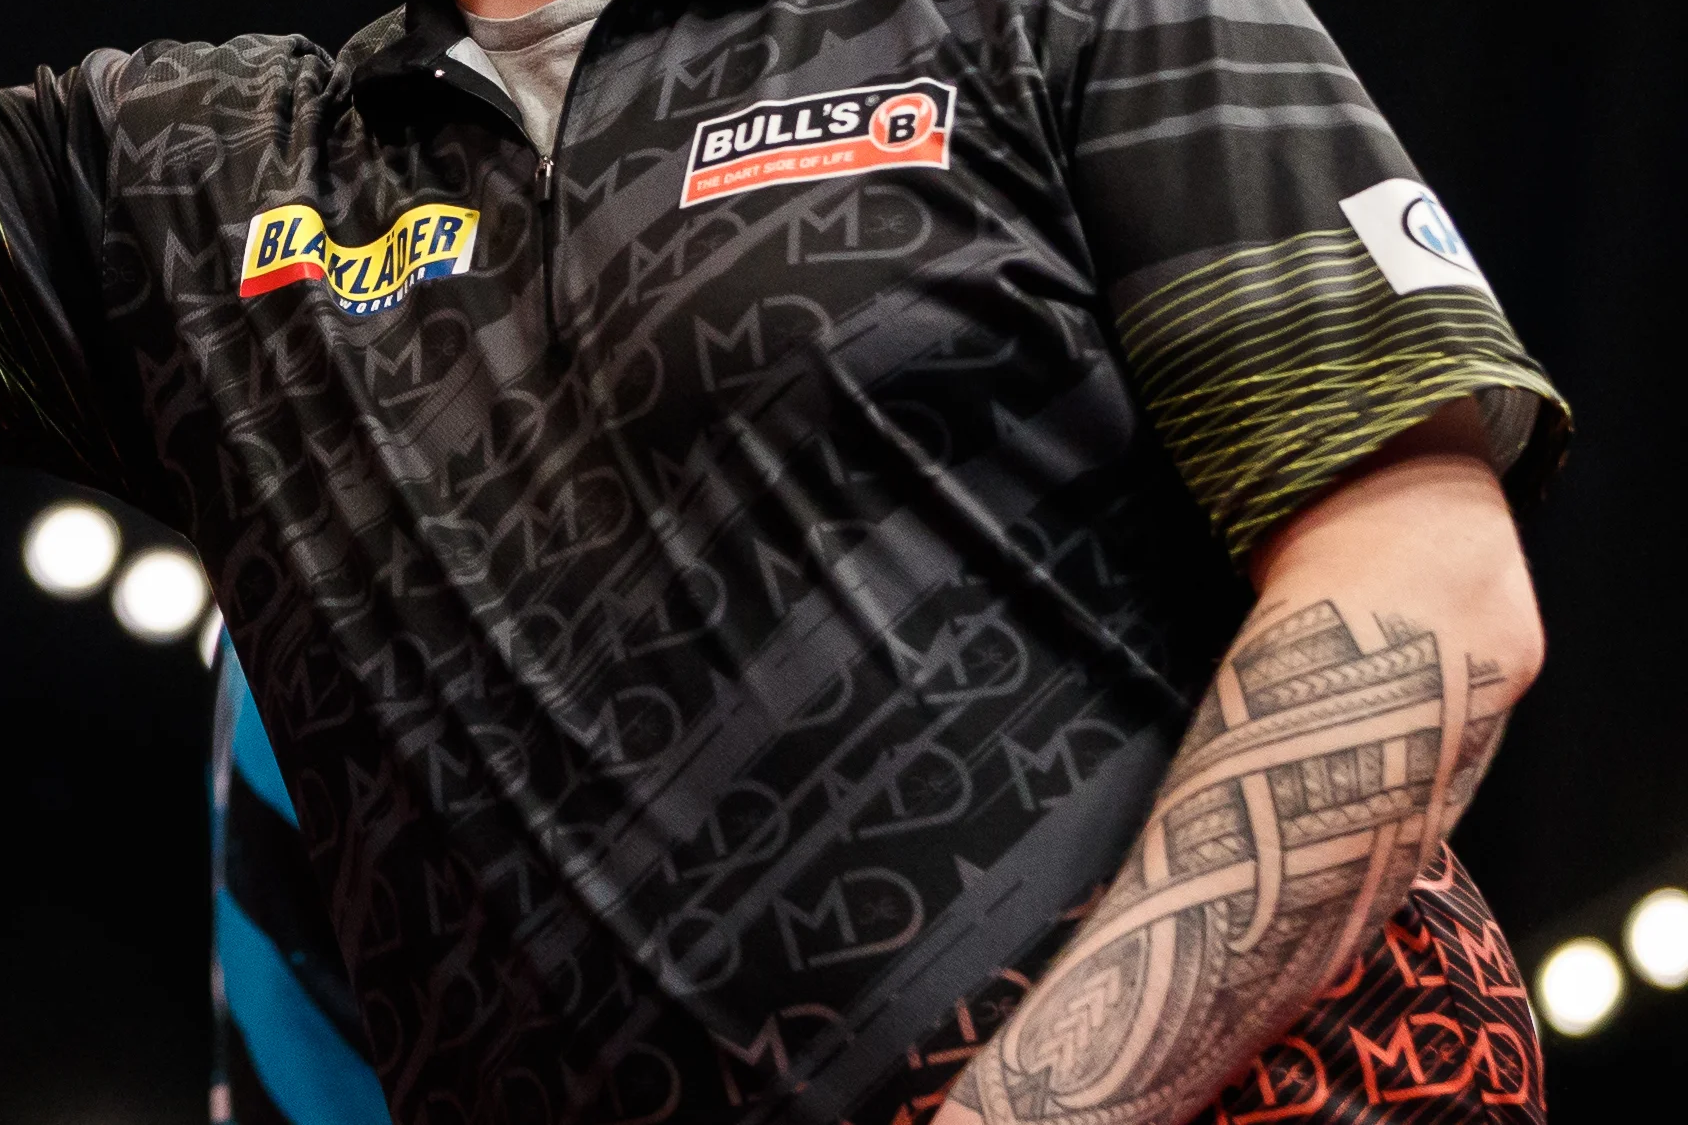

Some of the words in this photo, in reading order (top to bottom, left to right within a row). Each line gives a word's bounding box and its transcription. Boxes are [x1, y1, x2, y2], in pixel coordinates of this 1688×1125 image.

[702, 102, 860, 162] BULL'S
[697, 176, 721, 191] THE
[724, 165, 760, 184] DART
[763, 158, 797, 173] SIDE
[799, 155, 822, 168] OF
[823, 151, 854, 166] LIFE
